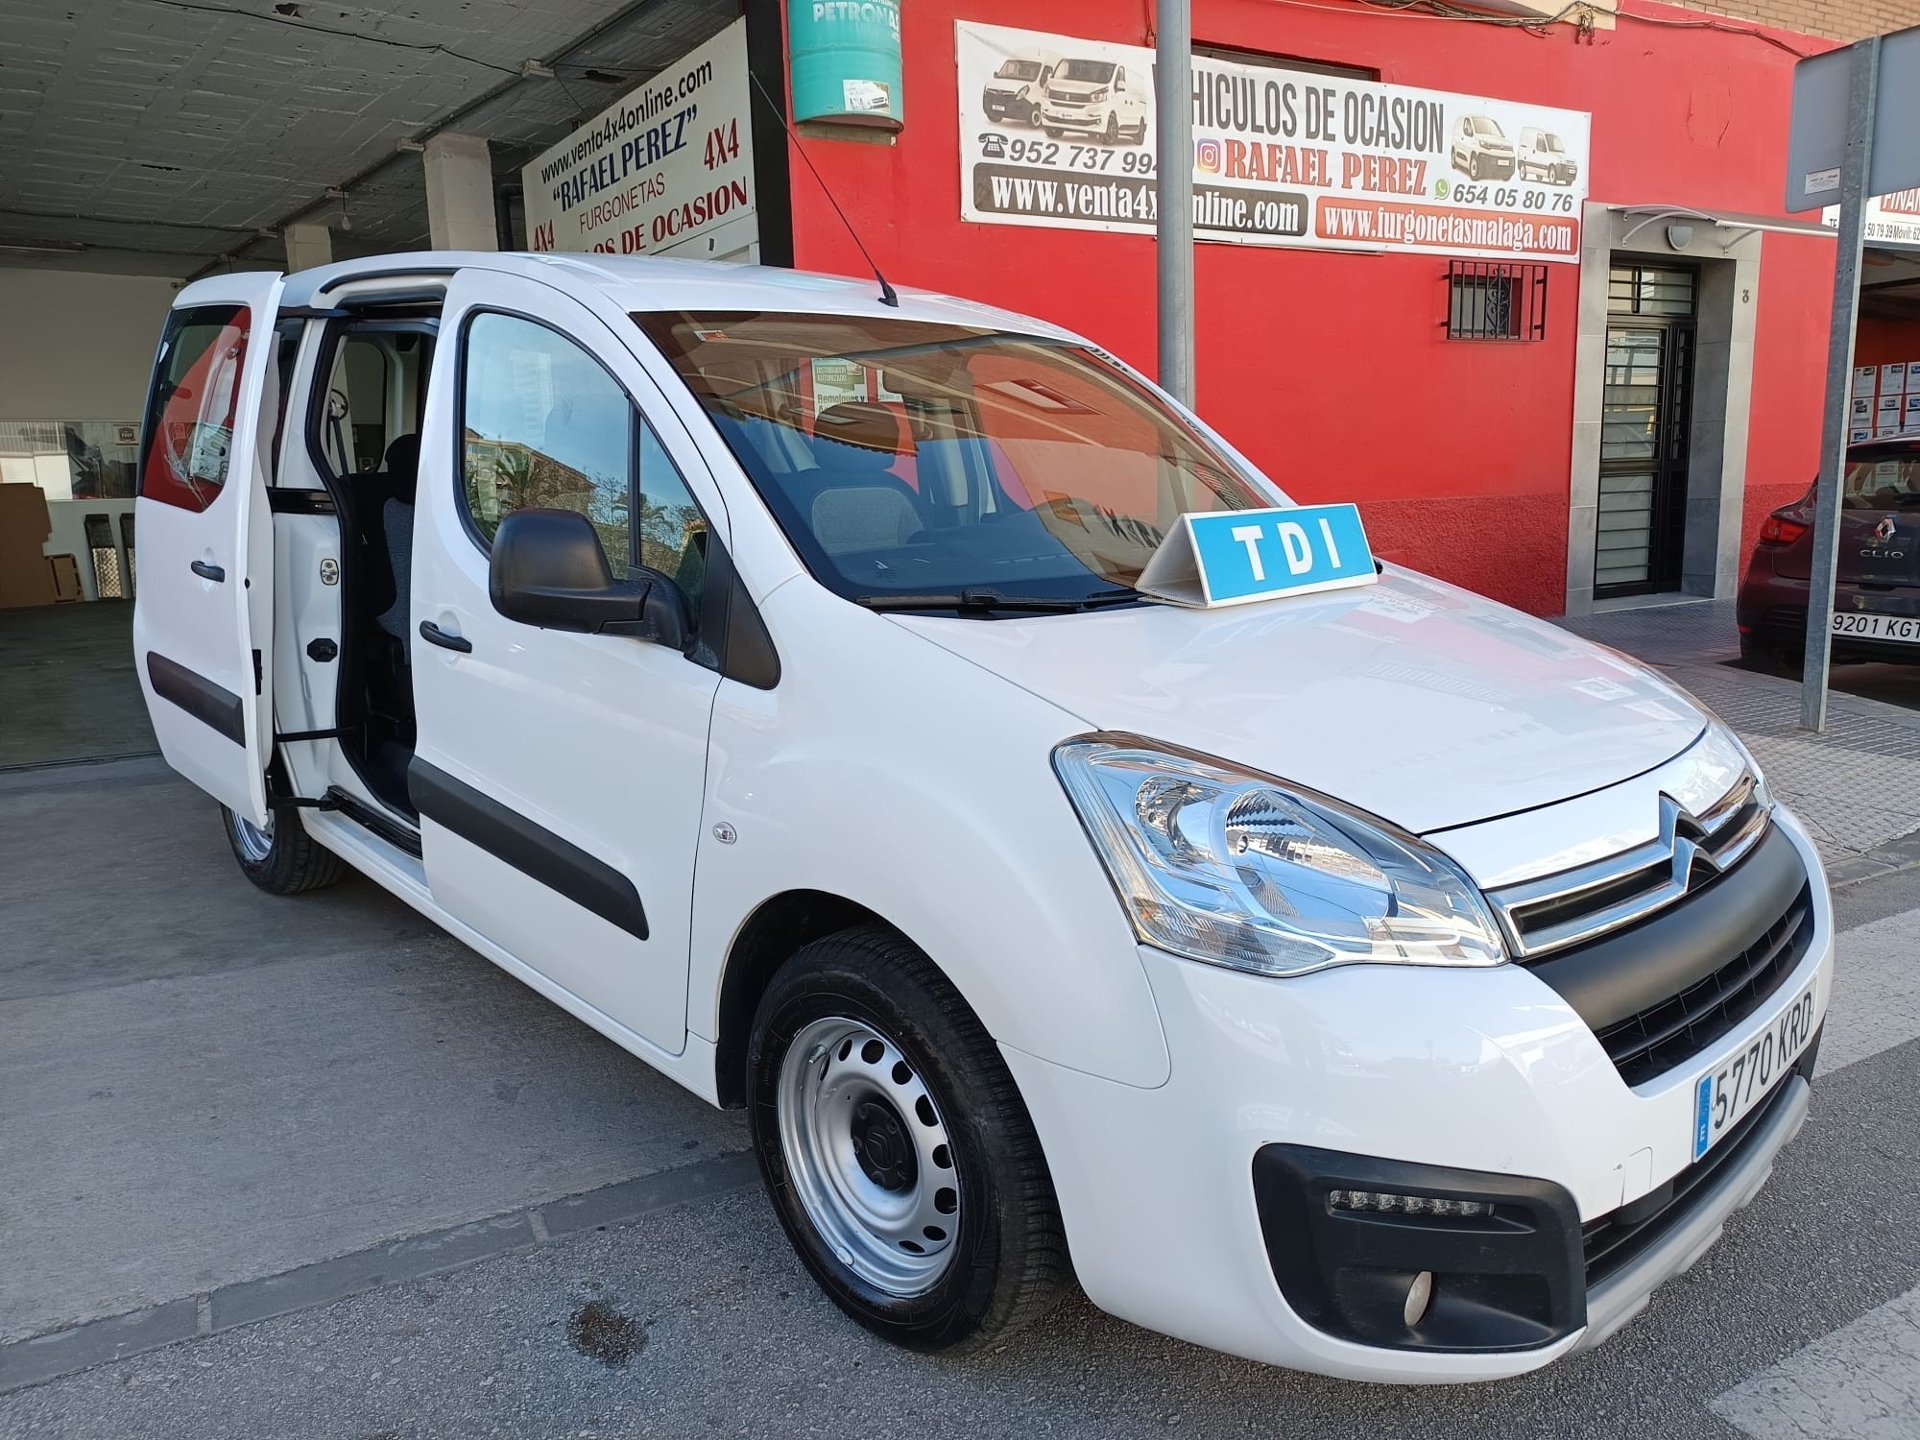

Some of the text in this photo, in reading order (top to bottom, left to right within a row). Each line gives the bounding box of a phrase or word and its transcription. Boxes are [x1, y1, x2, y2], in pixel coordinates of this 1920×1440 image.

[541, 60, 713, 184] www.venta4x4online.com
[1152, 63, 1444, 154] HICULOS DE OCASION
[704, 117, 740, 171] 4X4
[1009, 138, 1060, 166] 952
[1069, 145, 1114, 171] 737
[1225, 138, 1427, 196] RAFAEL PEREZ
[579, 172, 665, 234] FURGONETAS
[621, 176, 747, 255] DE OCASION
[990, 176, 1299, 232] www.venta4xnline.com
[1453, 184, 1573, 212] 654 05 80 76
[534, 219, 555, 251] 4X4
[1324, 206, 1571, 251] www.furgonetasmalaga.com
[1876, 223, 1885, 237] 79
[1860, 549, 1904, 559] CLIO
[1833, 614, 1920, 639] 9201 KGT
[1714, 1031, 1773, 1130] 5770
[1777, 991, 1812, 1070] KRD
